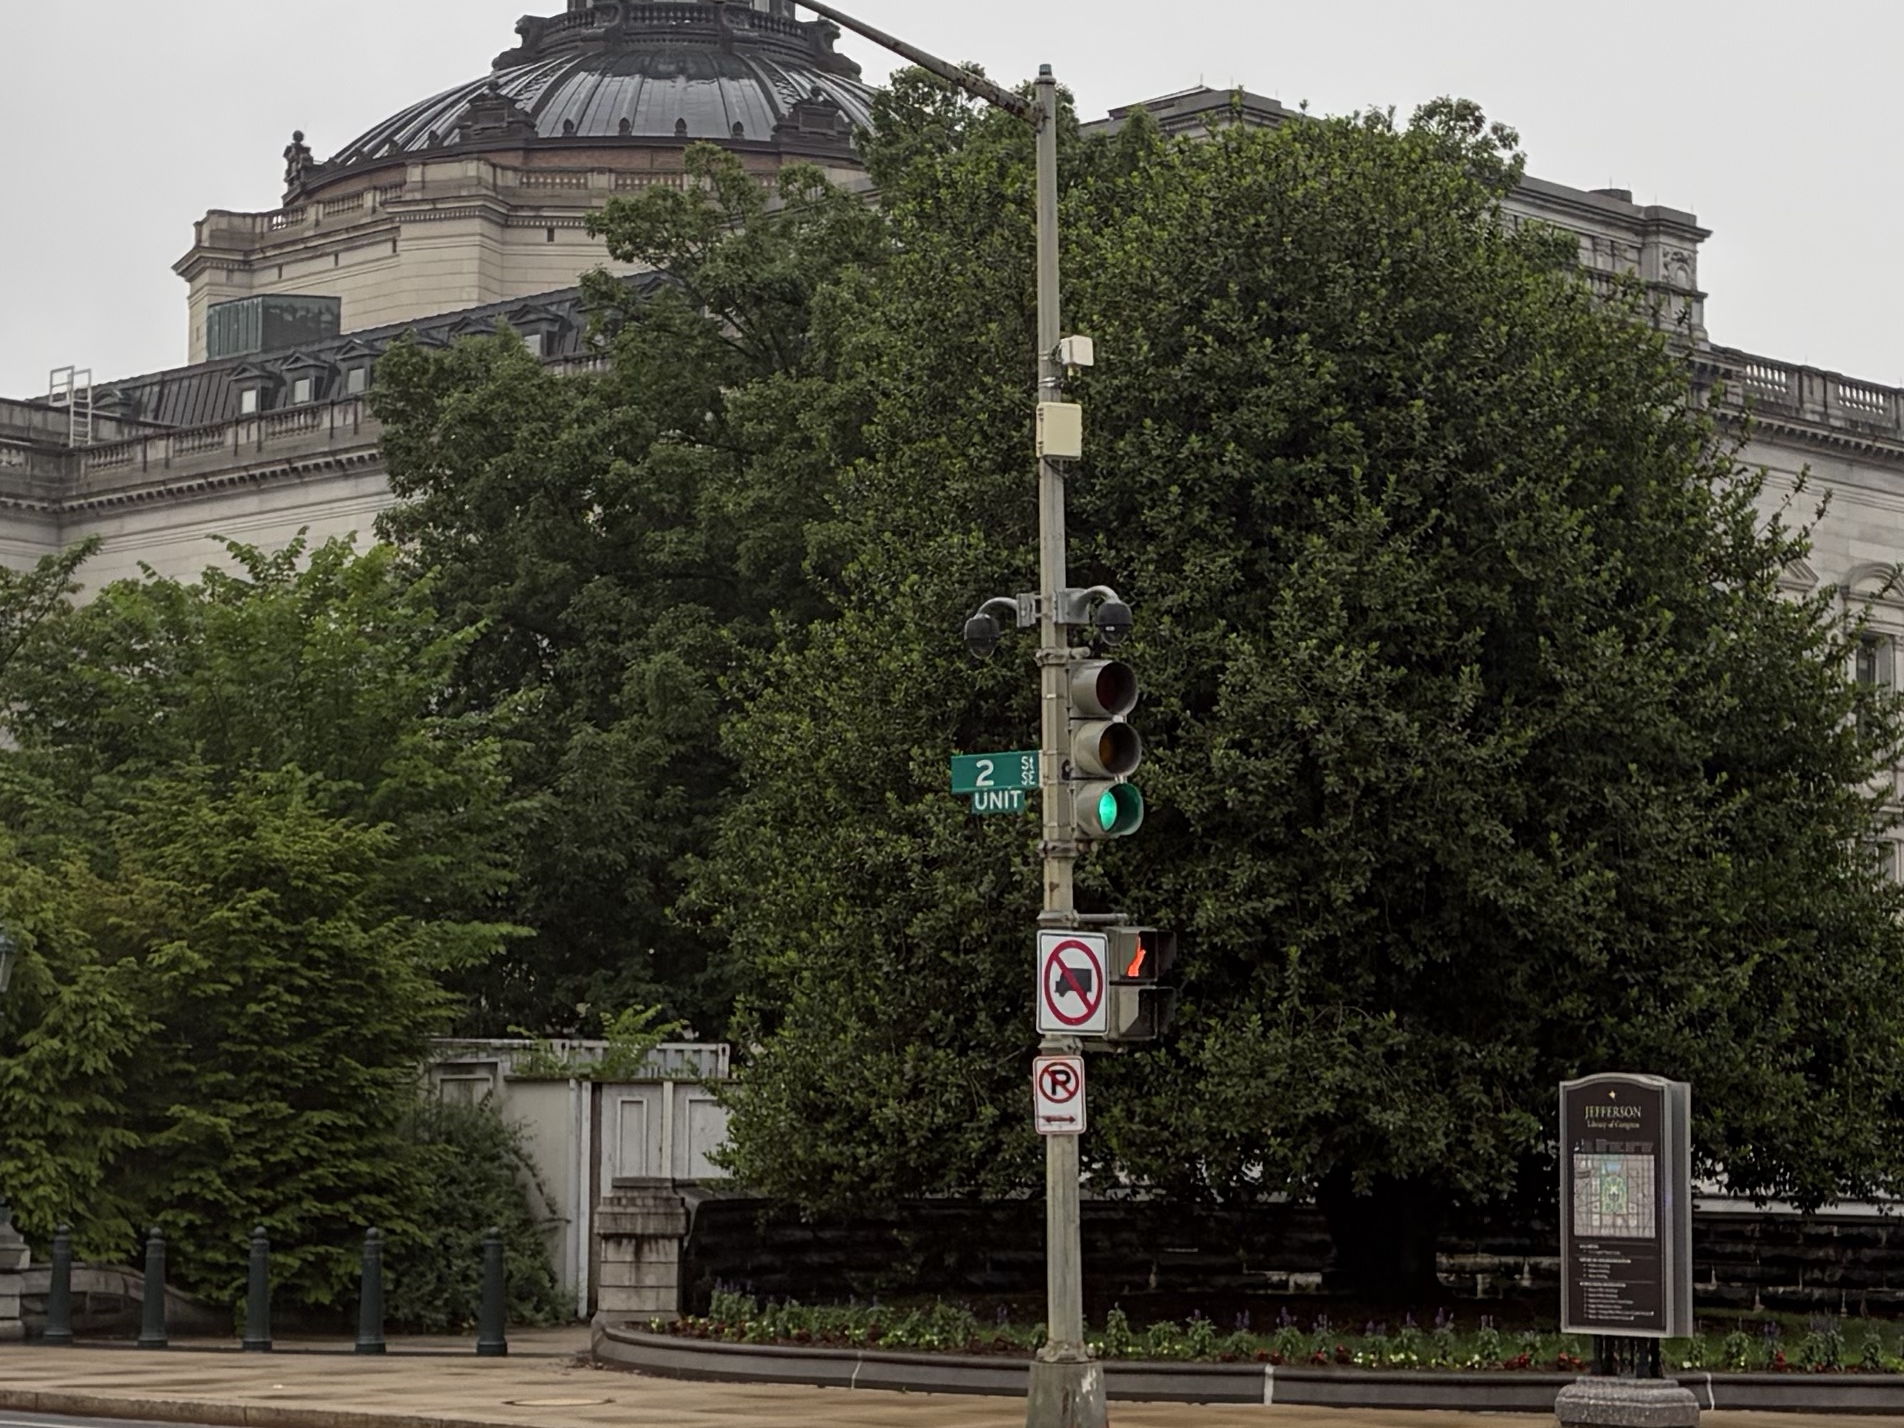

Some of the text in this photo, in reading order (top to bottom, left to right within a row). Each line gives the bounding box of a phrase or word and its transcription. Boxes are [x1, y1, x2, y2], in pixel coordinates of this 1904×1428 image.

[976, 759, 995, 787] 2
[1021, 771, 1036, 786] SE
[974, 790, 1022, 811] UNIT
[1585, 1105, 1642, 1120] JEFFERSON
